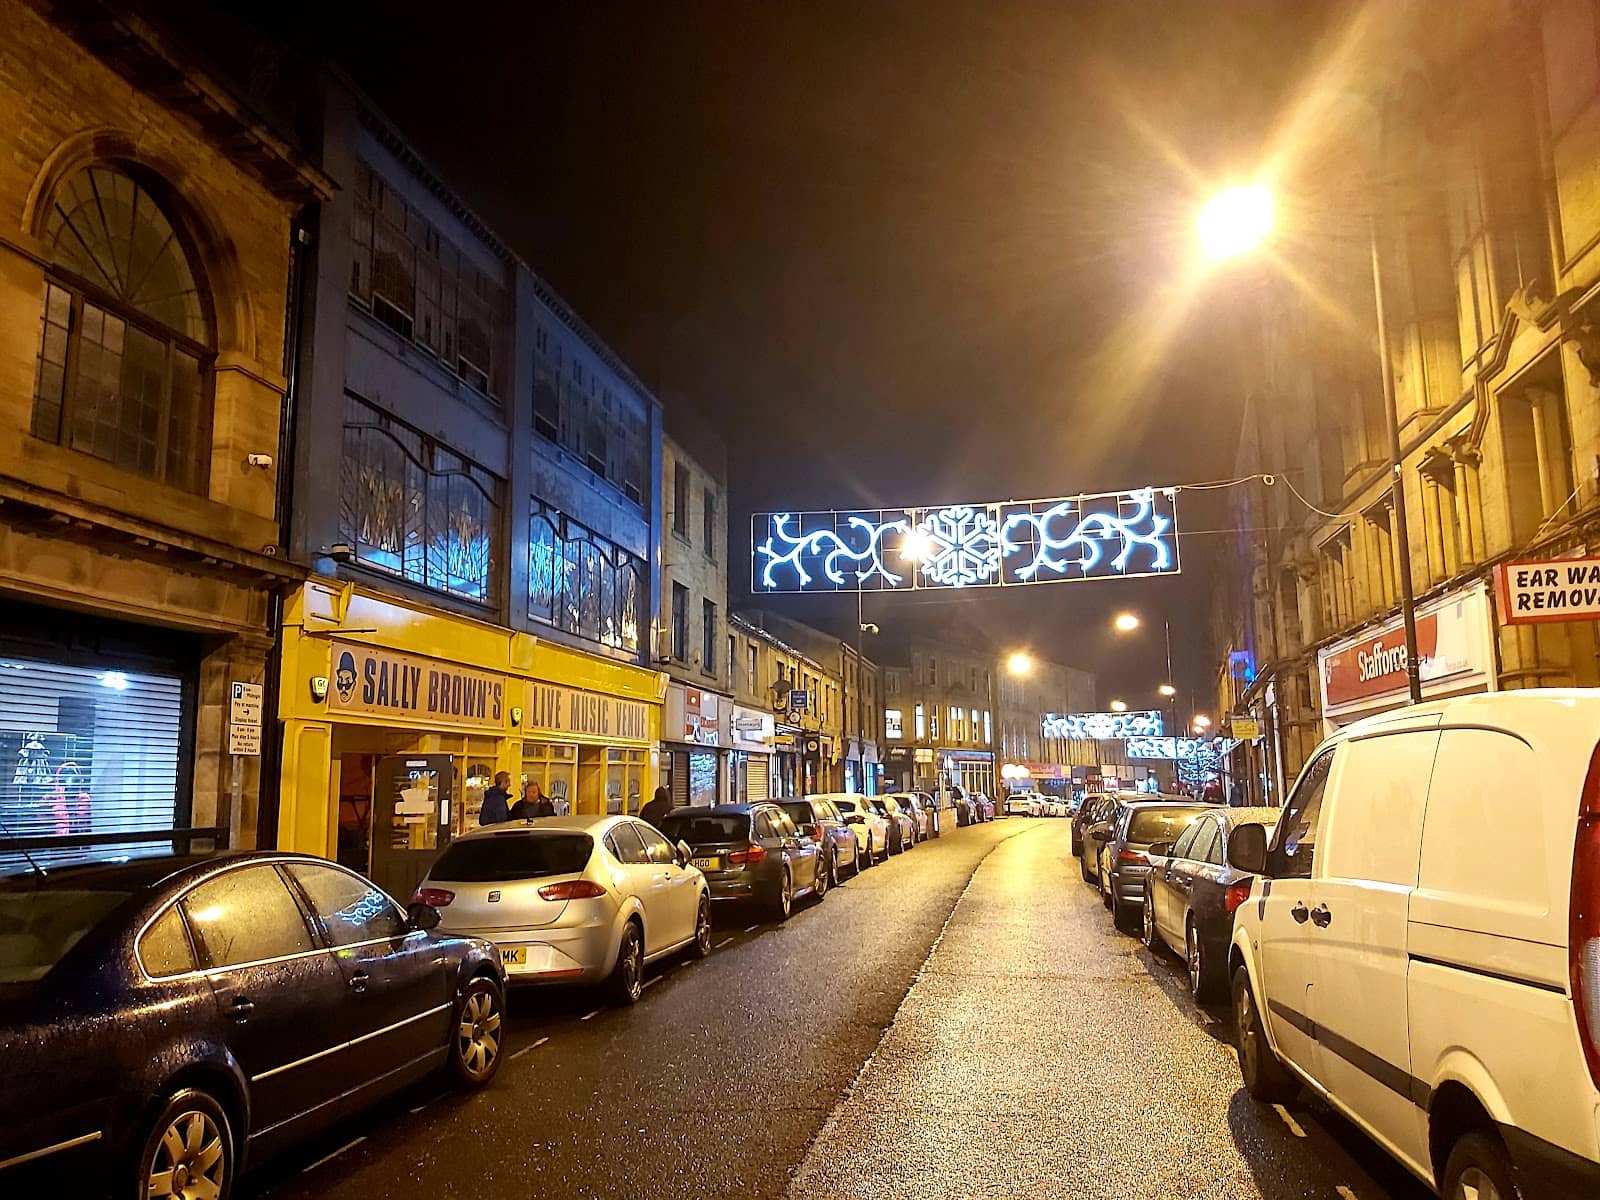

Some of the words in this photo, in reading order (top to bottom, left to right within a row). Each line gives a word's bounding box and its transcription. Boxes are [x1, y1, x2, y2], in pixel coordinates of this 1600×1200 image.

[1516, 569, 1559, 588] EAR
[1517, 588, 1600, 612] REMOV
[1358, 641, 1407, 683] Stafforce
[234, 684, 242, 698] P
[363, 658, 421, 710] SALLY
[428, 670, 502, 720] BROWN'S
[532, 686, 561, 728] LIVE
[571, 693, 609, 736] MUSIC
[616, 702, 645, 738] VENUE
[502, 949, 519, 963] MK
